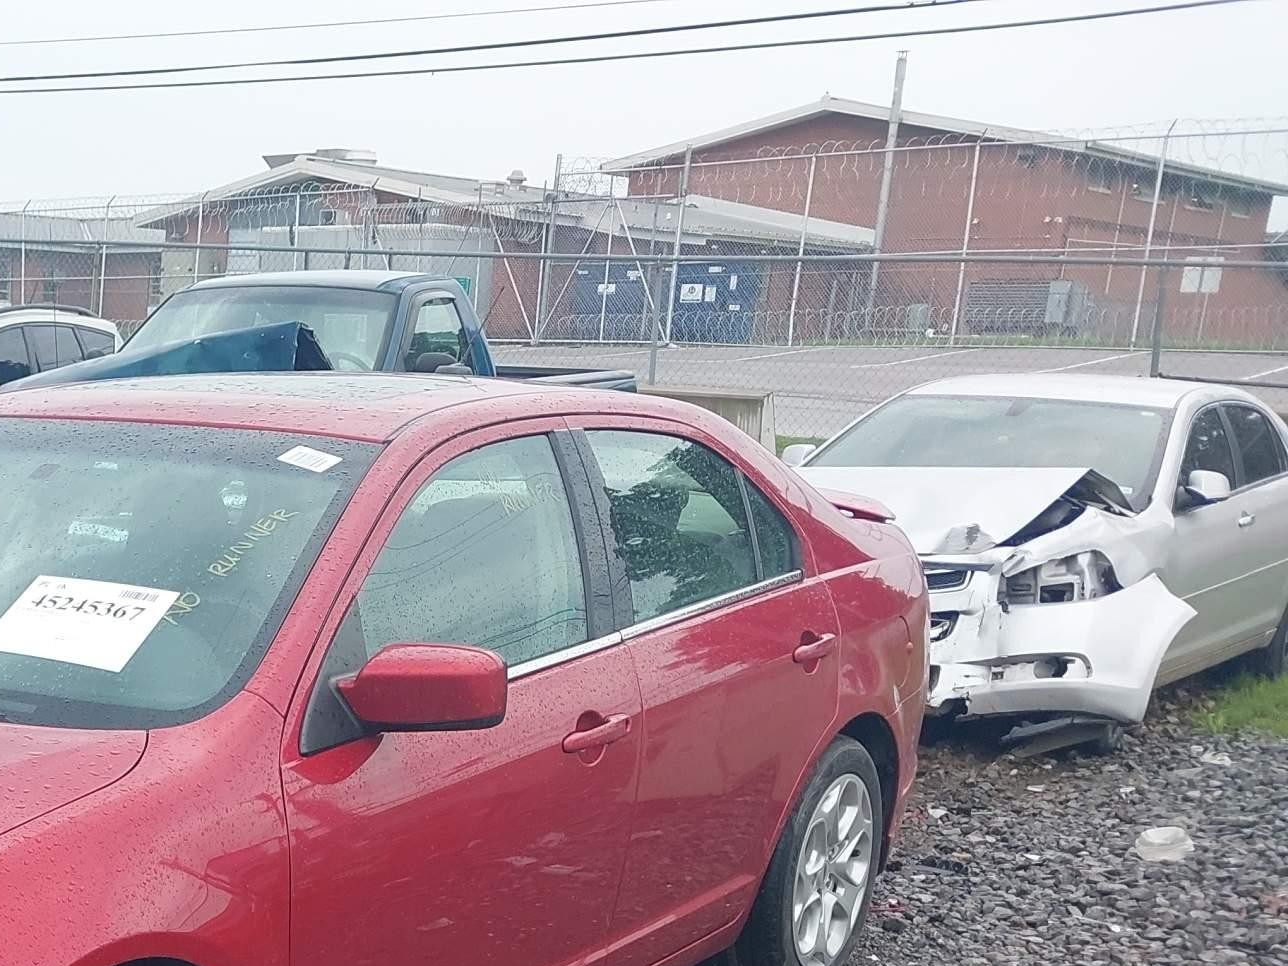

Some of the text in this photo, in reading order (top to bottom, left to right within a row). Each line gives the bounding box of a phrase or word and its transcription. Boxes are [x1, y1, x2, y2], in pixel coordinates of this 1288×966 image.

[162, 508, 300, 625] NO RUNNER
[31, 594, 146, 621] 45245367
